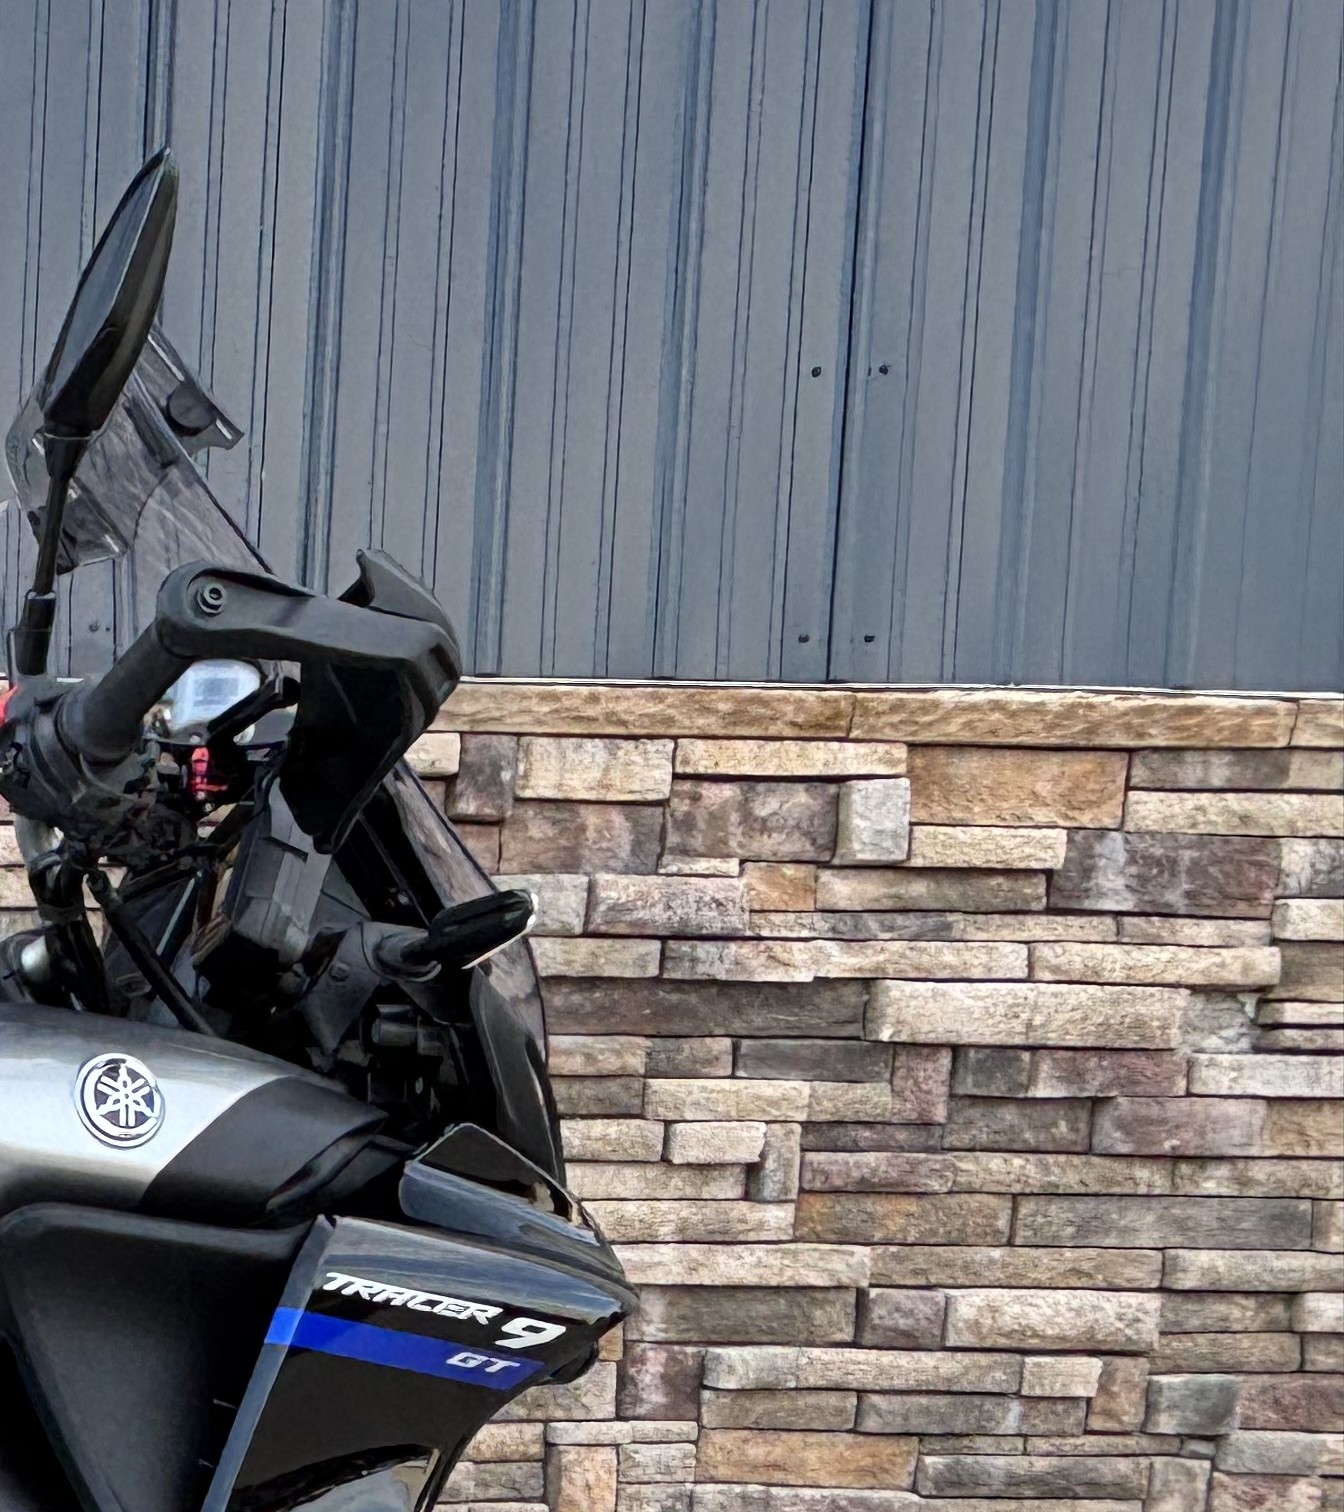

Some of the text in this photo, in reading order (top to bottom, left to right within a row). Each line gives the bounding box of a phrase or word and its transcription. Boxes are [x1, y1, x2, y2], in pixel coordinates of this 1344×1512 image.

[322, 1272, 567, 1349] TRACER 9
[446, 1351, 521, 1373] GT
